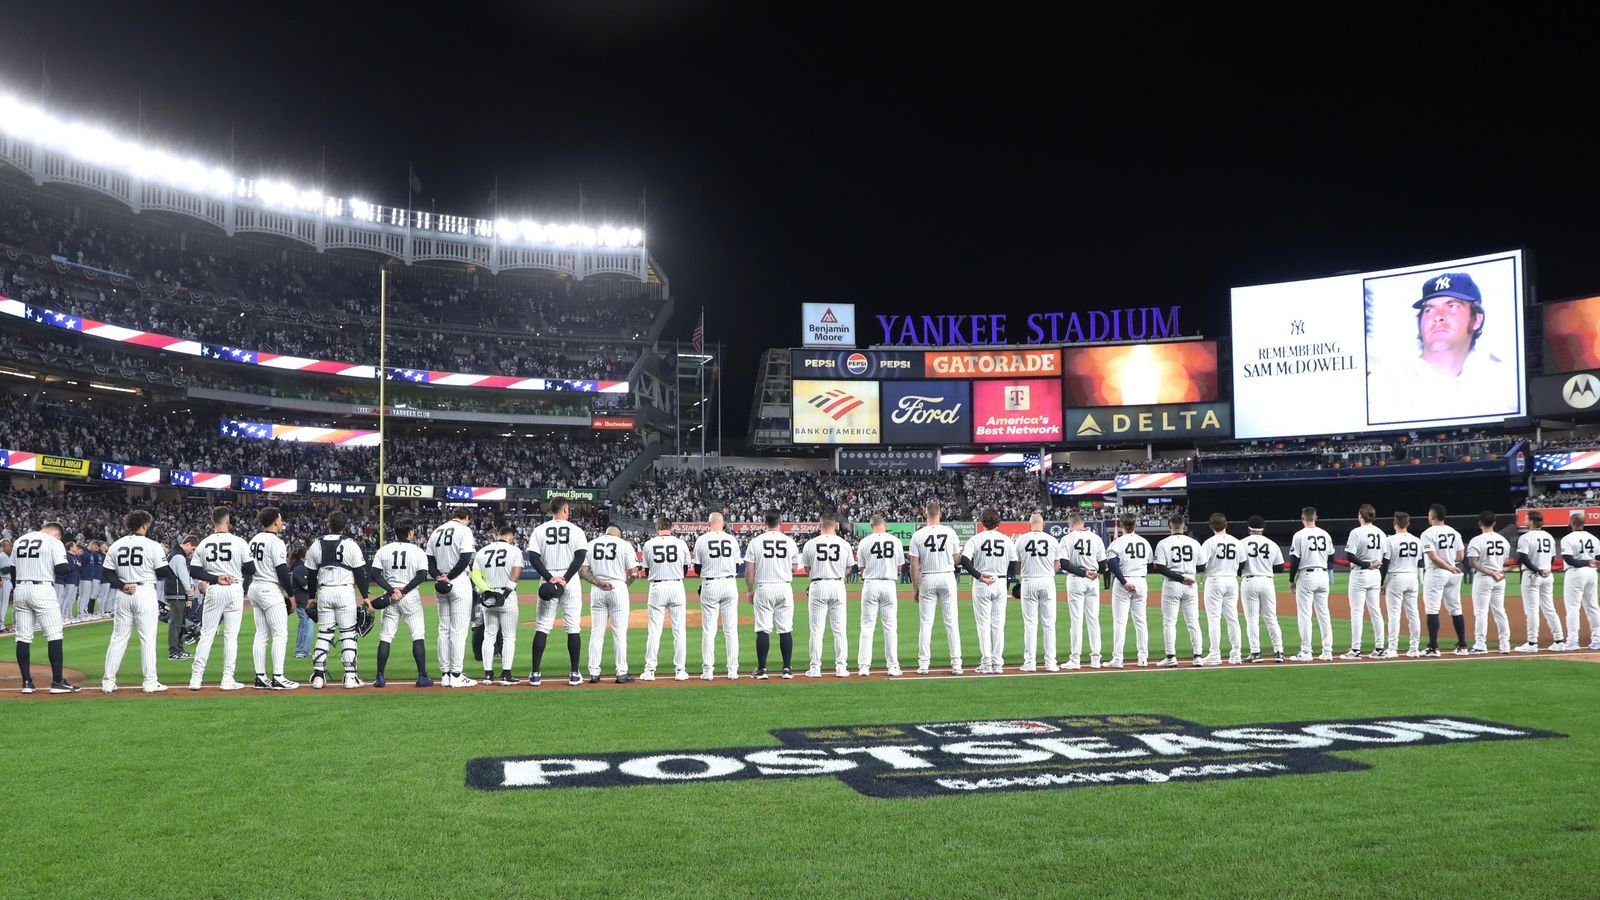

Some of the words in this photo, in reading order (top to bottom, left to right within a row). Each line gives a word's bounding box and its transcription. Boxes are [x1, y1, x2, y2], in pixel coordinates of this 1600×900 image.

[809, 323, 850, 335] Benjamin
[876, 314, 1008, 346] YANKEE
[1027, 305, 1182, 344] STADIUM
[814, 333, 843, 342] Moore
[1258, 341, 1341, 360] REMEMBERING
[805, 359, 836, 368] PEPSI
[848, 360, 867, 368] PEPSI
[880, 360, 911, 369] PEPSI
[933, 353, 1055, 373] GATORADE
[1243, 361, 1273, 379] SAM
[1276, 355, 1358, 376] McDOWELL
[891, 395, 962, 424] Ford
[986, 415, 1049, 426] America's
[1112, 409, 1221, 433] DELTA
[795, 428, 820, 436] BANK
[822, 428, 835, 436] OF
[836, 428, 878, 436] AMERICA
[976, 426, 1009, 435] Best
[1012, 425, 1059, 436] Network
[386, 484, 422, 497] ORIS
[570, 491, 593, 500] Spring
[435, 527, 453, 546] 78
[545, 526, 570, 545] 99
[924, 534, 948, 552] 47
[1308, 535, 1327, 551] 33
[1367, 533, 1381, 550] 31
[1438, 533, 1456, 549] 27
[16, 538, 41, 559] 22
[205, 542, 232, 562] 35
[593, 542, 617, 561] 63
[653, 545, 678, 563] 58
[708, 539, 732, 558] 56
[763, 540, 787, 558] 55
[816, 543, 841, 562] 53
[870, 541, 894, 559] 48
[981, 539, 1005, 557] 45
[1025, 540, 1049, 557] 43
[1074, 538, 1092, 556] 41
[1125, 542, 1146, 559] 40
[1171, 545, 1193, 563] 39
[1216, 543, 1236, 560] 36
[1247, 541, 1271, 559] 34
[1399, 541, 1419, 557] 29
[1486, 540, 1505, 556] 25
[1536, 538, 1551, 553] 19
[1579, 539, 1594, 554] 14
[117, 546, 144, 567] 26
[391, 550, 407, 570] 11
[484, 549, 507, 567] 72
[503, 718, 1531, 787] POSTSEASON
